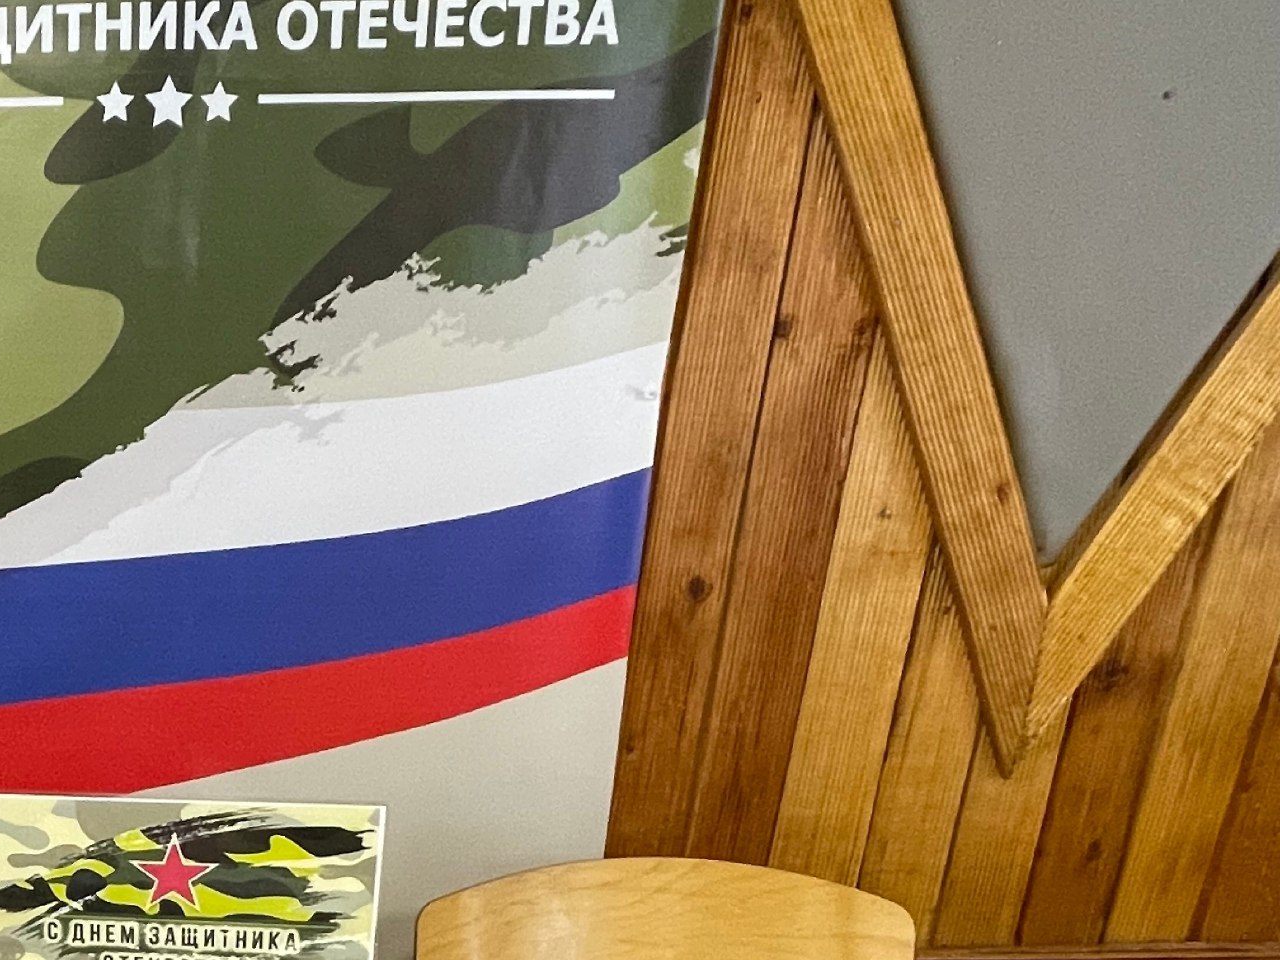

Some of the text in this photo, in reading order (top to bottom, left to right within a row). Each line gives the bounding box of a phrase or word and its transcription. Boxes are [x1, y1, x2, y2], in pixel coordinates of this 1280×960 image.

[275, 0, 620, 51] ОТЕЧЕСТВА
[45, 918, 61, 942] С
[148, 924, 299, 954] ЗАЩИТНИКА
